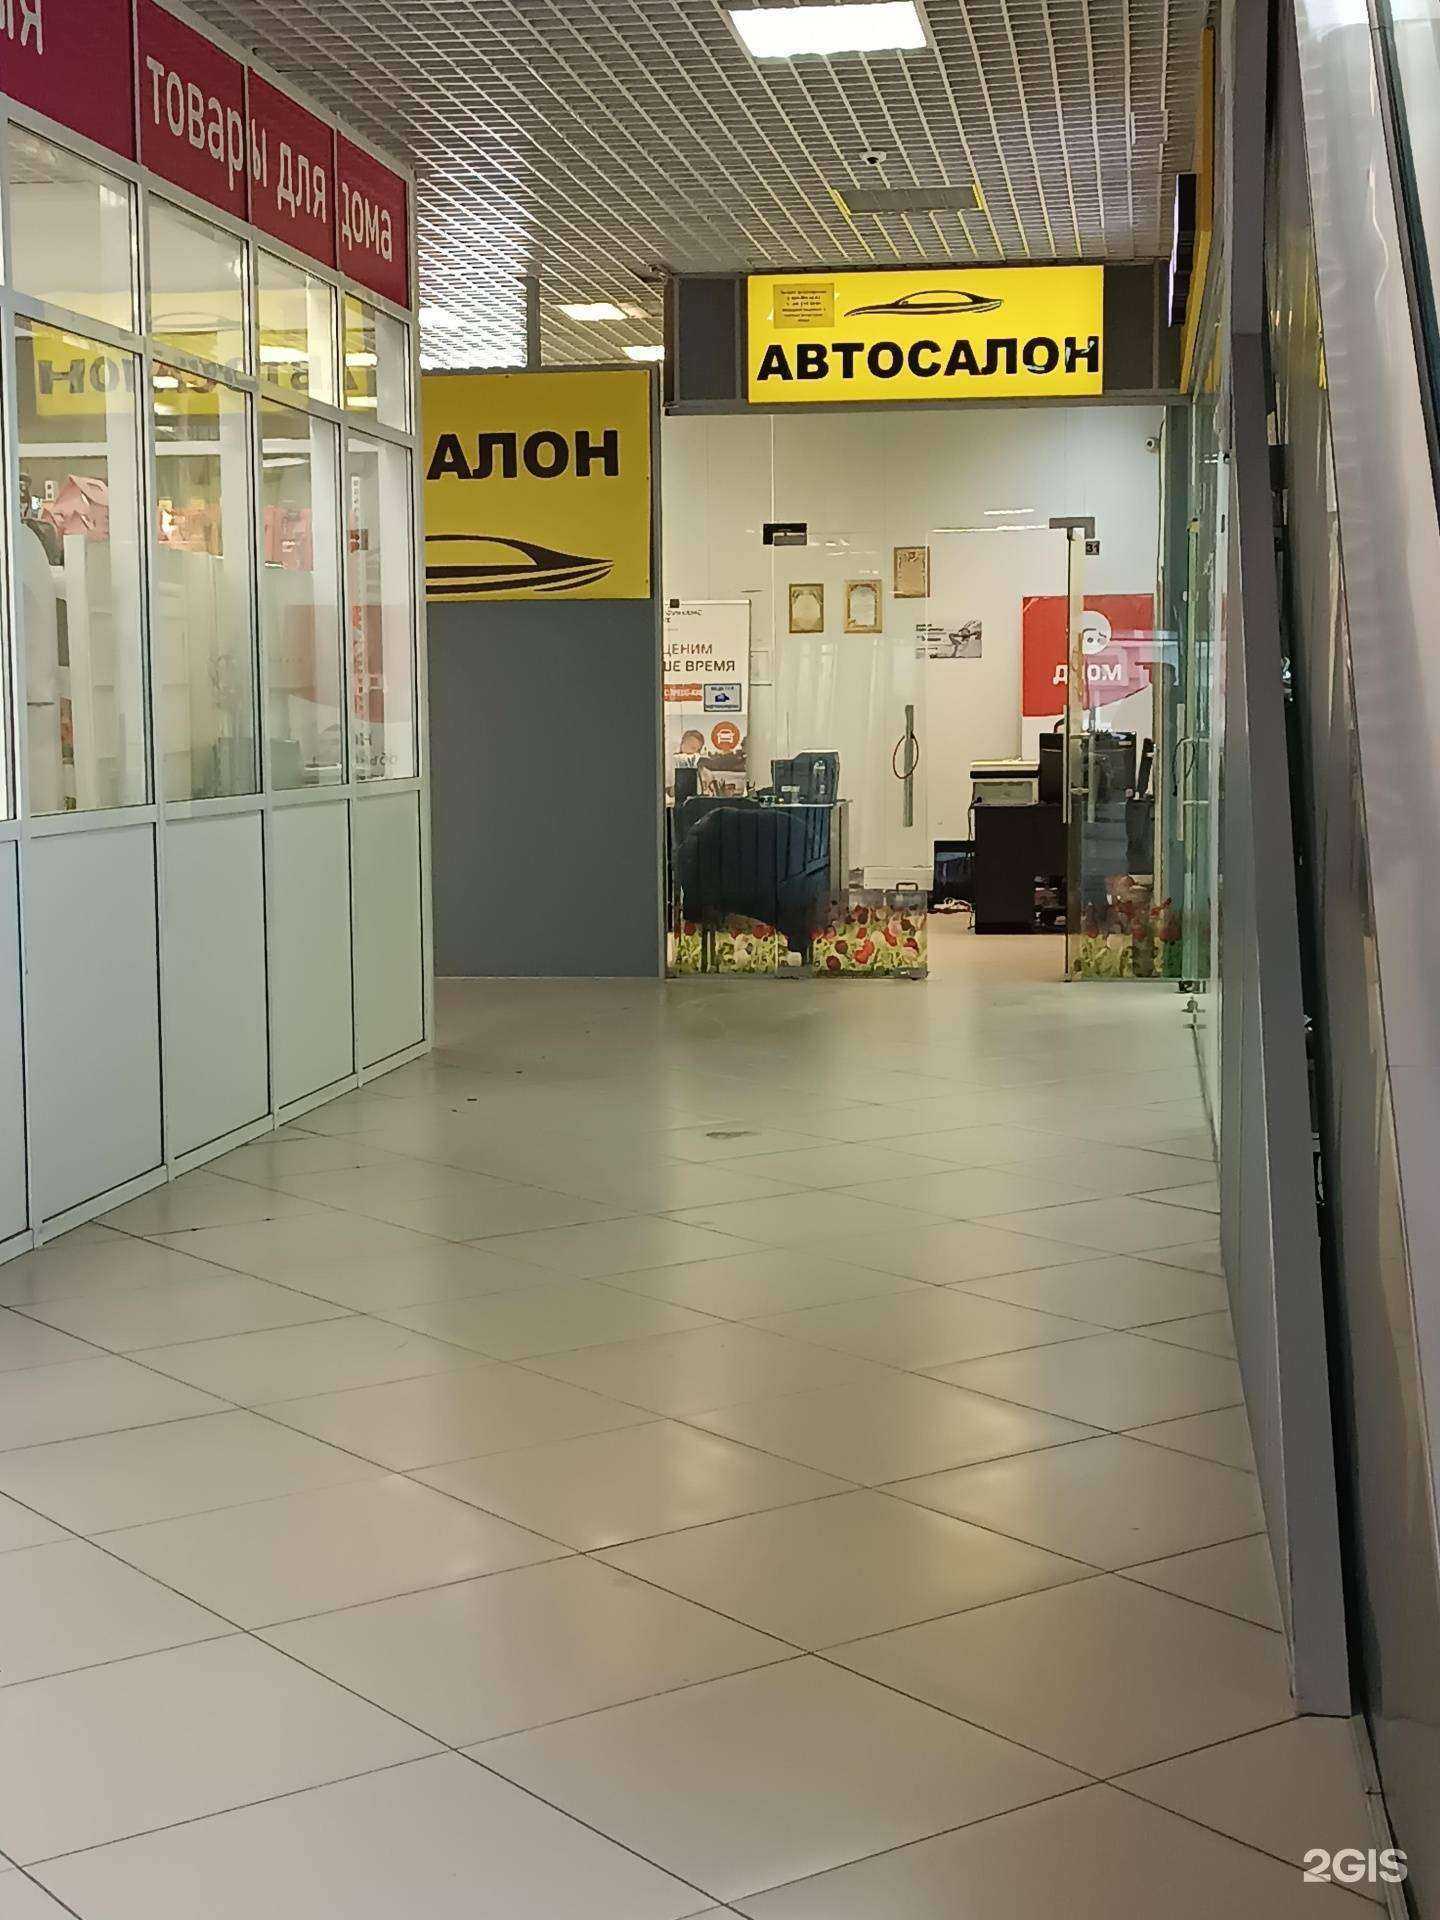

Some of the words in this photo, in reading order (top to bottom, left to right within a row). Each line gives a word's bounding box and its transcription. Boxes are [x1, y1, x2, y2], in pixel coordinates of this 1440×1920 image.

[147, 56, 267, 192] товары
[277, 142, 326, 223] для
[757, 336, 1100, 381] АВТОСАЛОН
[426, 429, 619, 480] АЛОН
[685, 660, 735, 672] ВРЕМЯ
